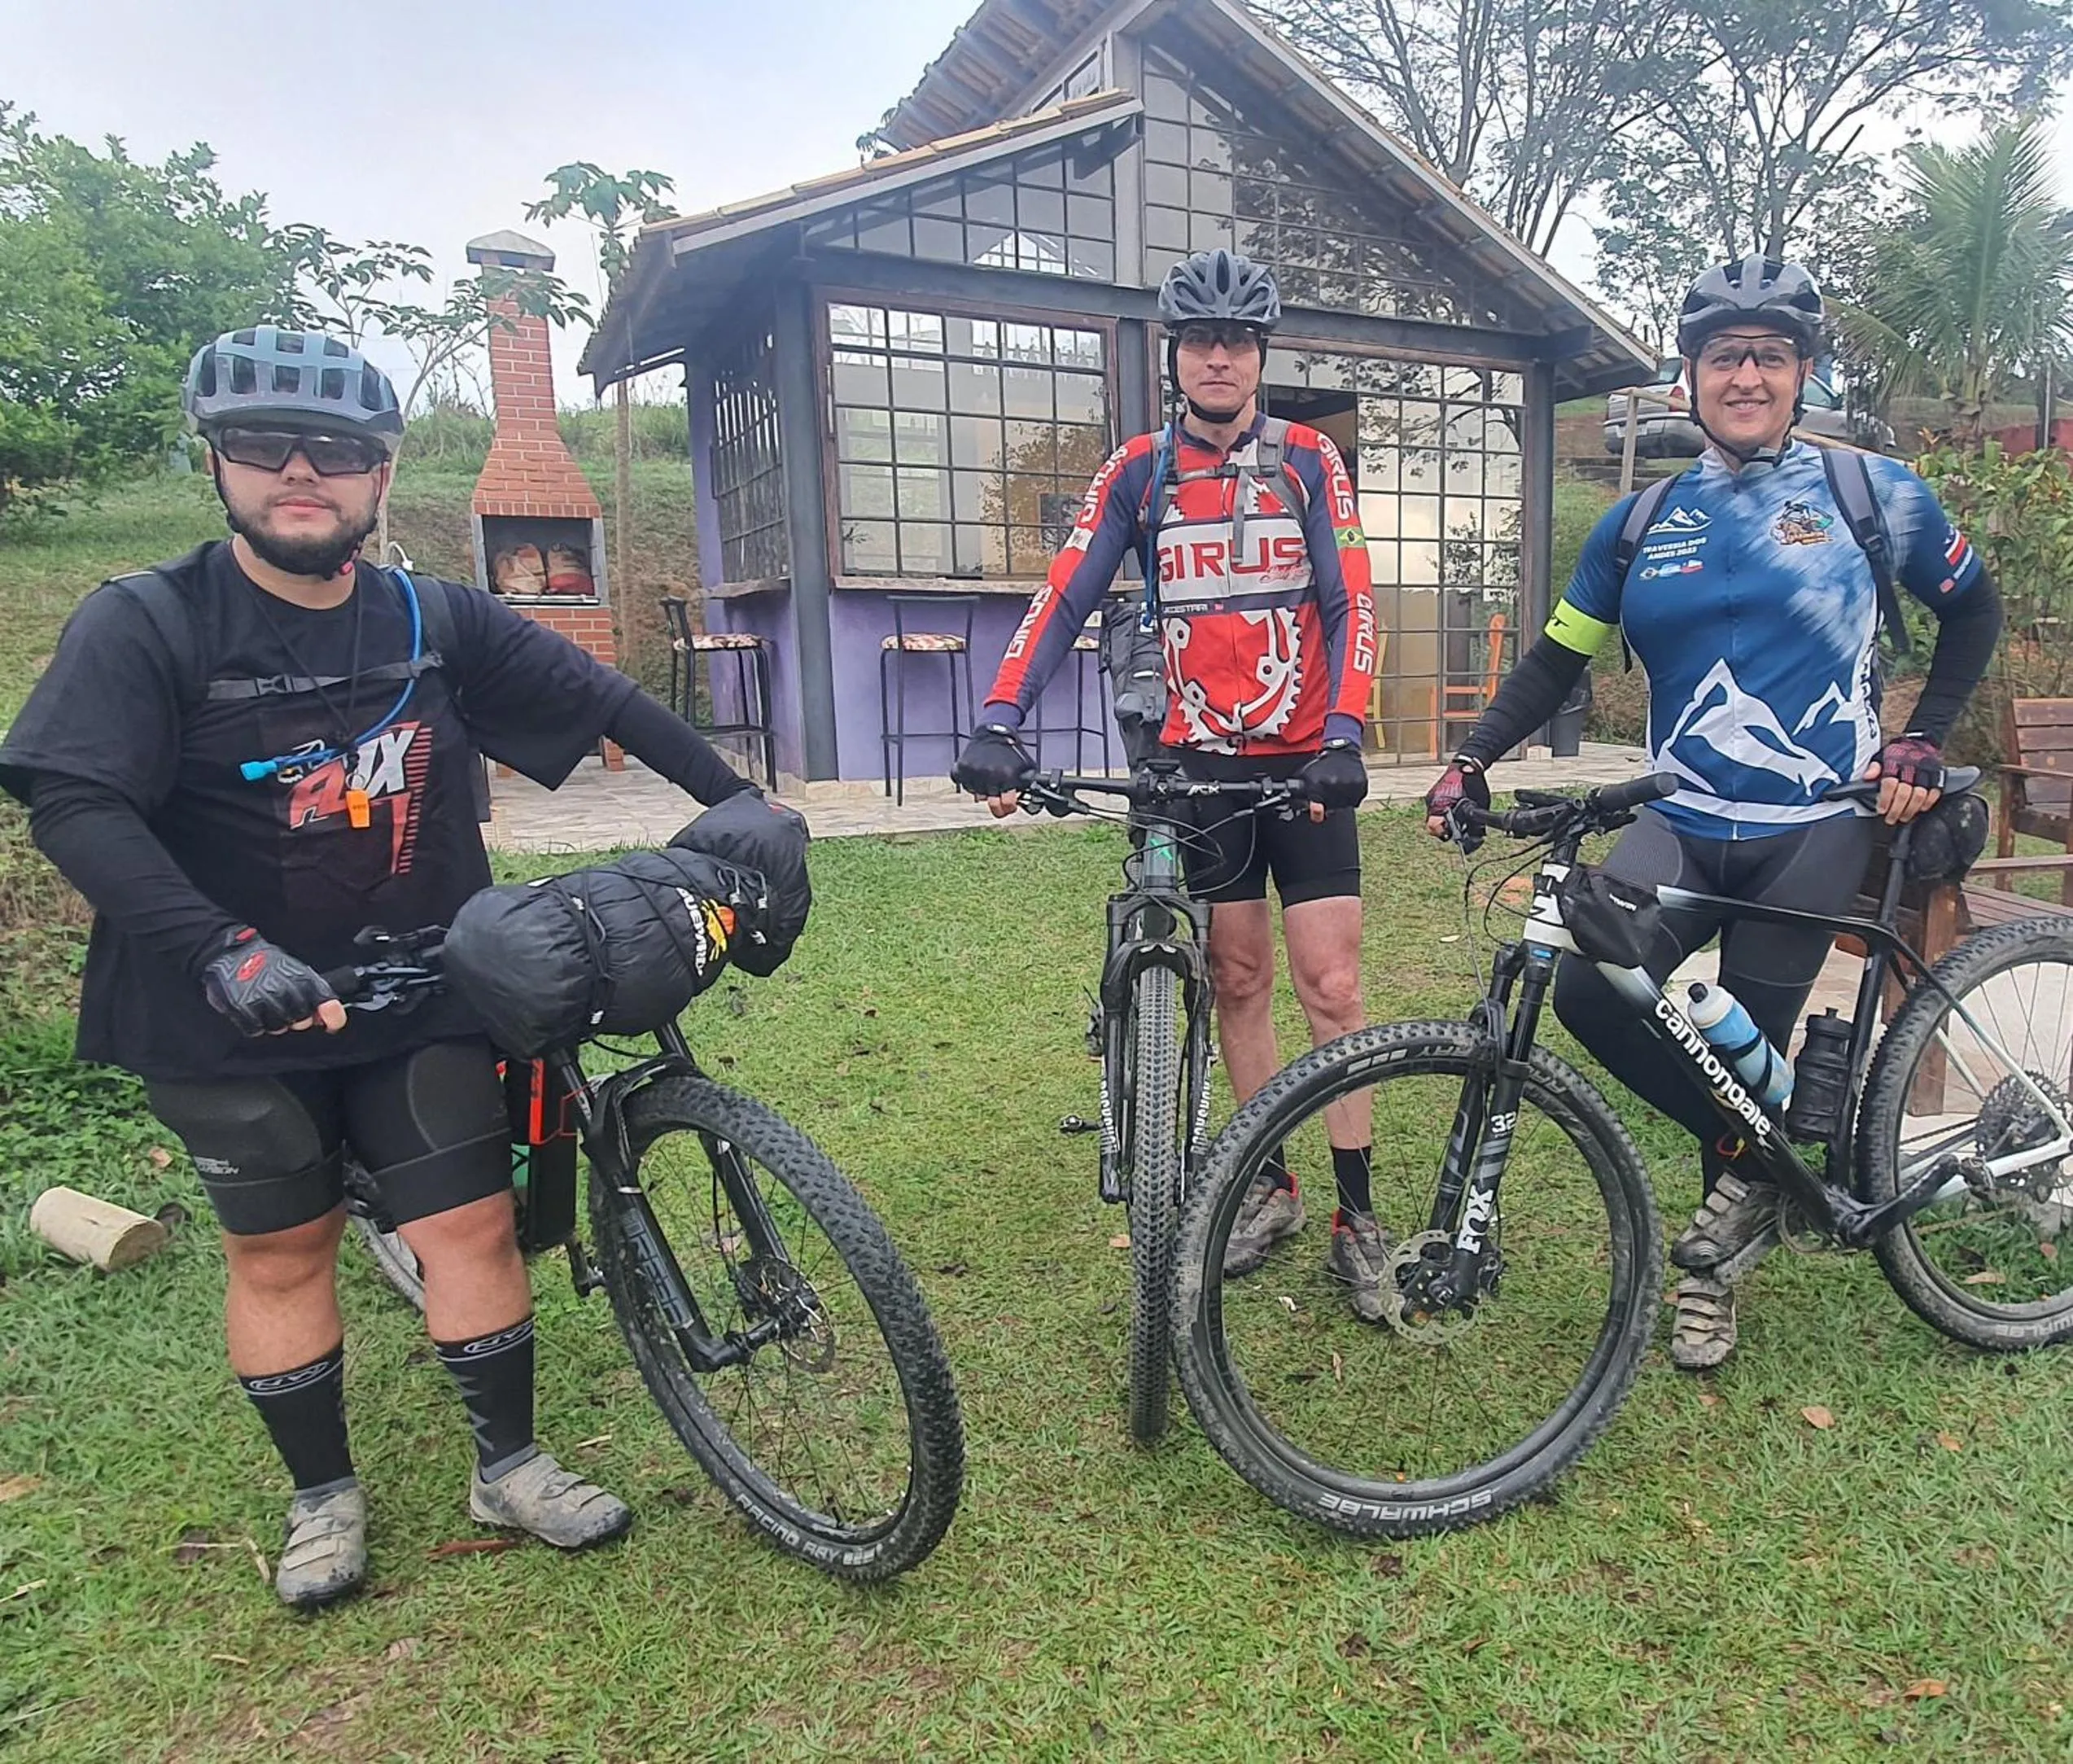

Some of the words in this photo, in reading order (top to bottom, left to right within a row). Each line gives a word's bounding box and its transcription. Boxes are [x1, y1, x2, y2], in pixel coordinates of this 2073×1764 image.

[1318, 432, 1354, 520] GIRUS
[1158, 536, 1307, 583] GIRUS
[1004, 583, 1053, 660] GIRUS
[1354, 592, 1377, 676] GIRUS
[1655, 998, 1772, 1136] cannondale
[1490, 1110, 1517, 1134] 32
[1455, 1184, 1494, 1255] FOX
[1318, 1491, 1494, 1521] SCHWALBE
